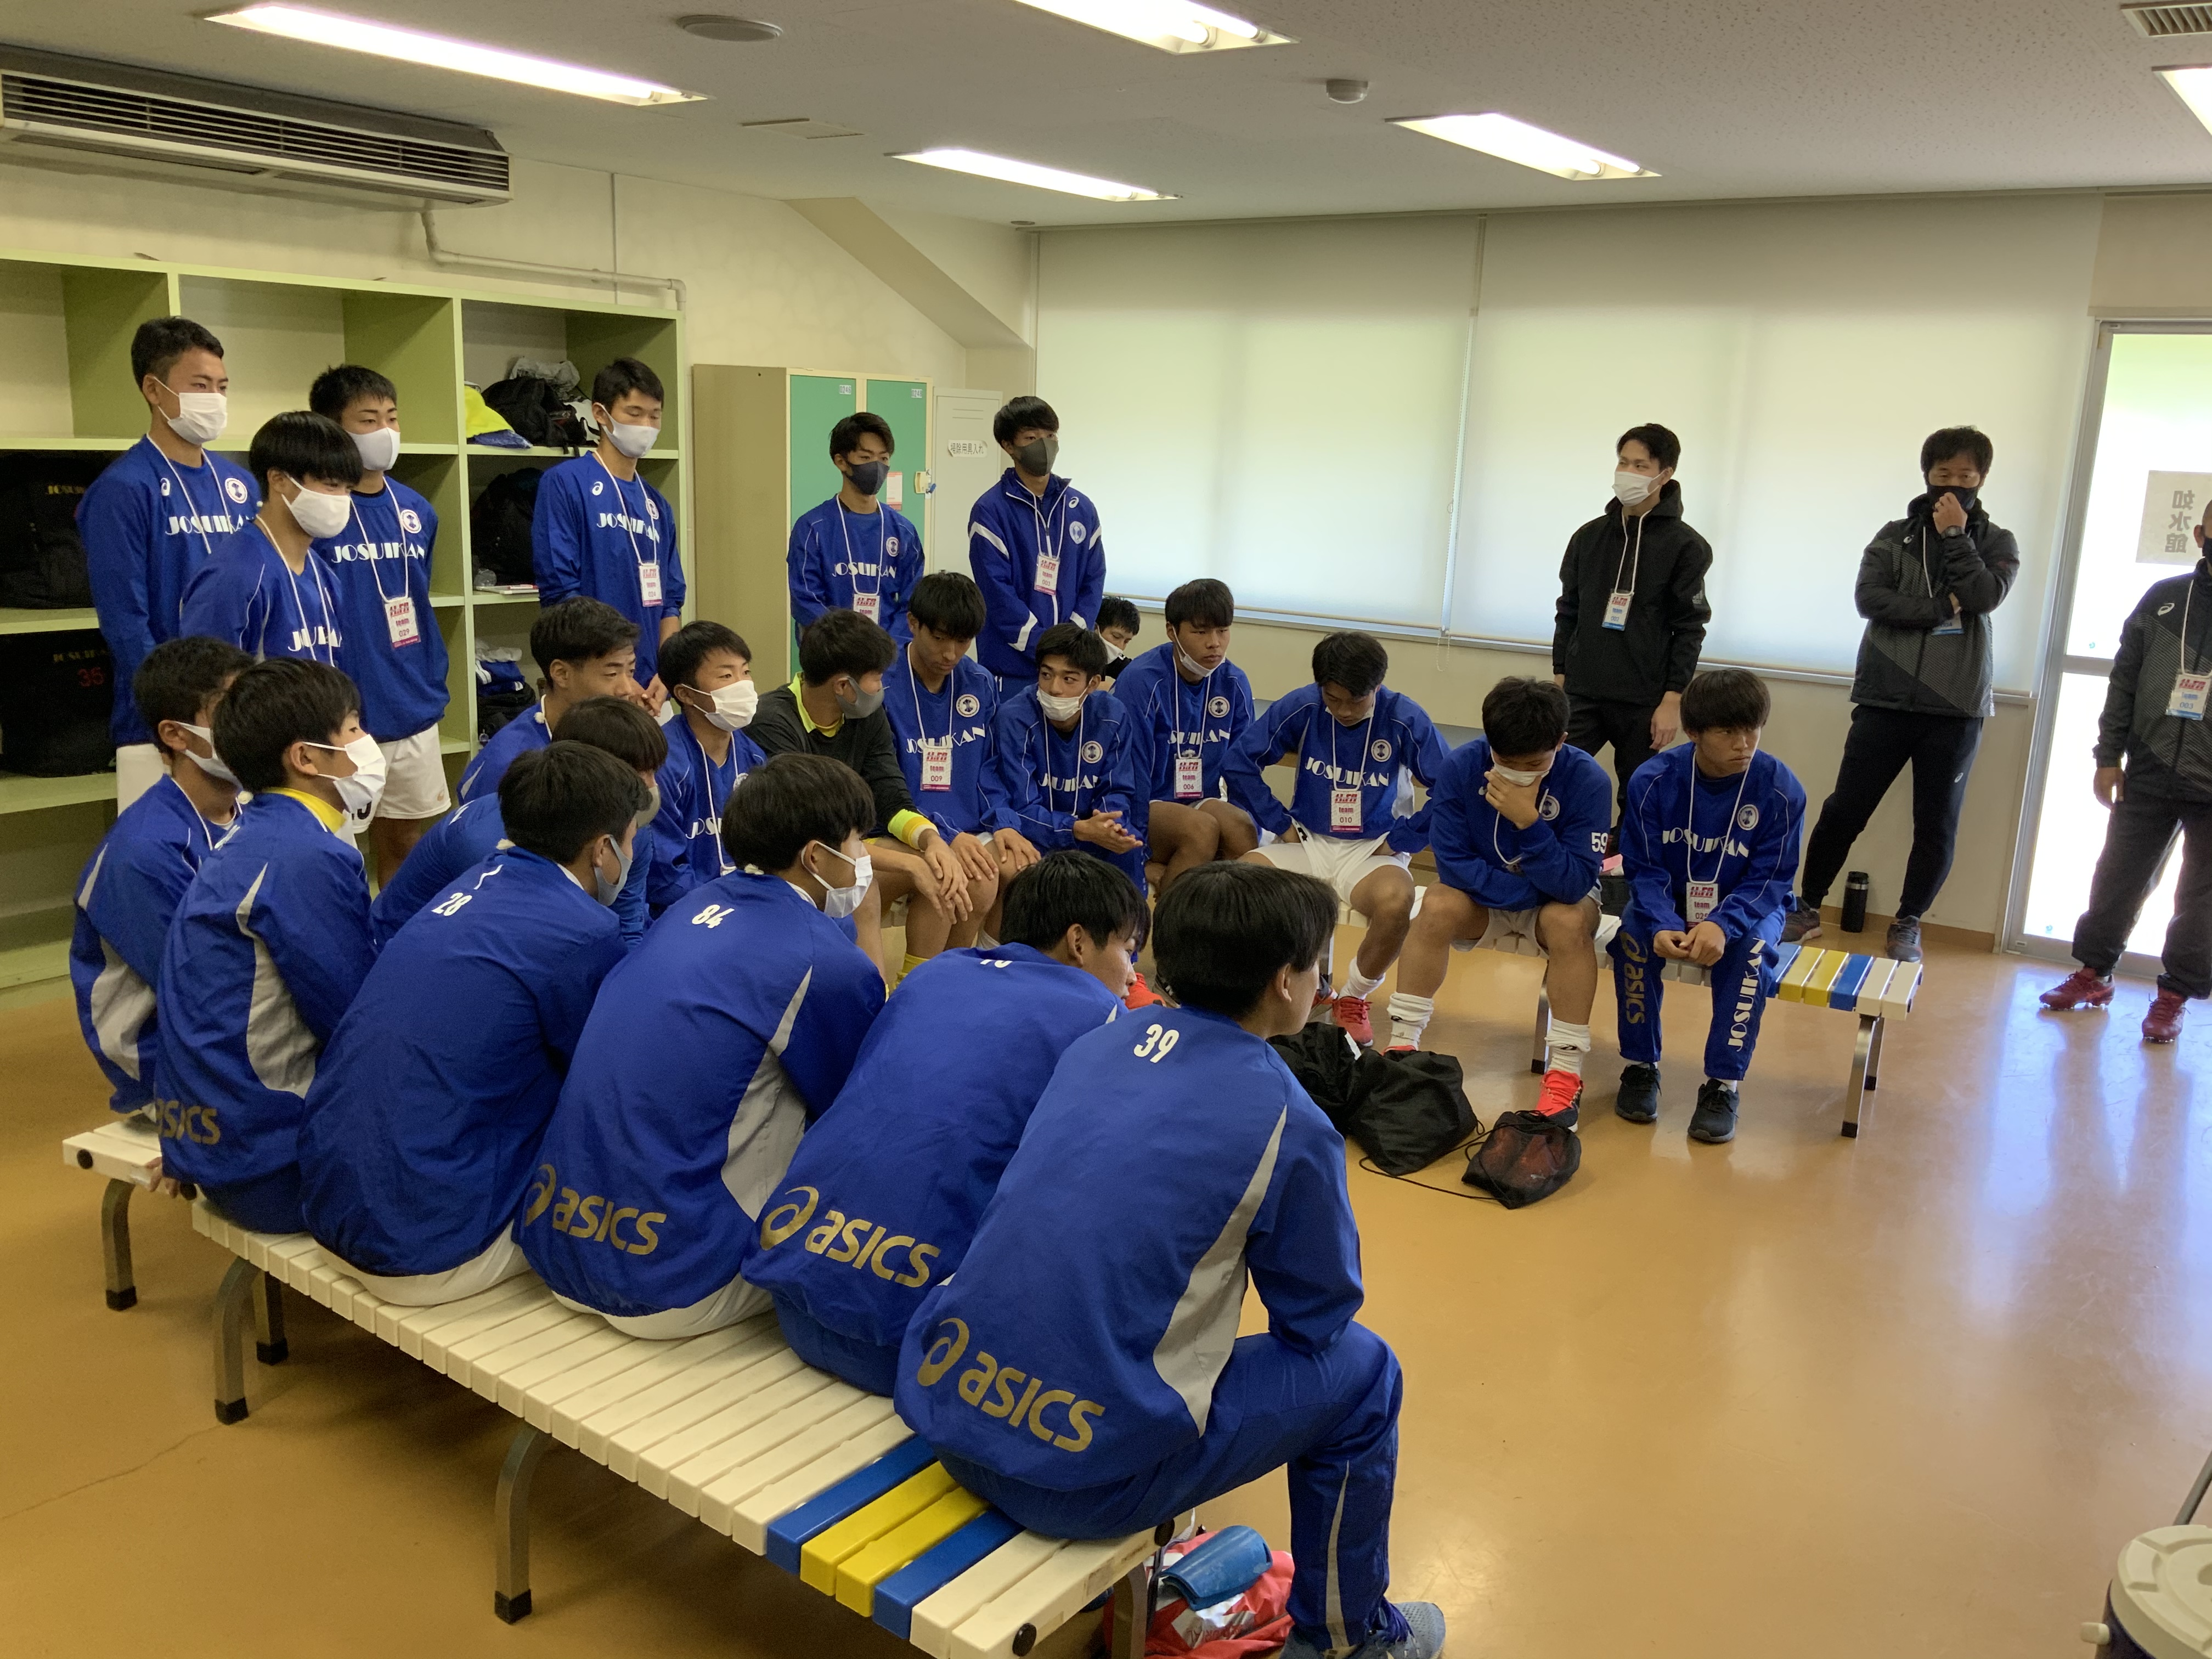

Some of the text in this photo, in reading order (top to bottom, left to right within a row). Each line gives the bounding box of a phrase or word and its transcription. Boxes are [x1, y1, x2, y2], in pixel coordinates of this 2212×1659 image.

[1591, 832, 1609, 854] 59
[431, 892, 472, 916] 28
[692, 904, 735, 928] 84
[1728, 937, 1766, 1052] JOSUIKAN
[1133, 1024, 1180, 1063] 39
